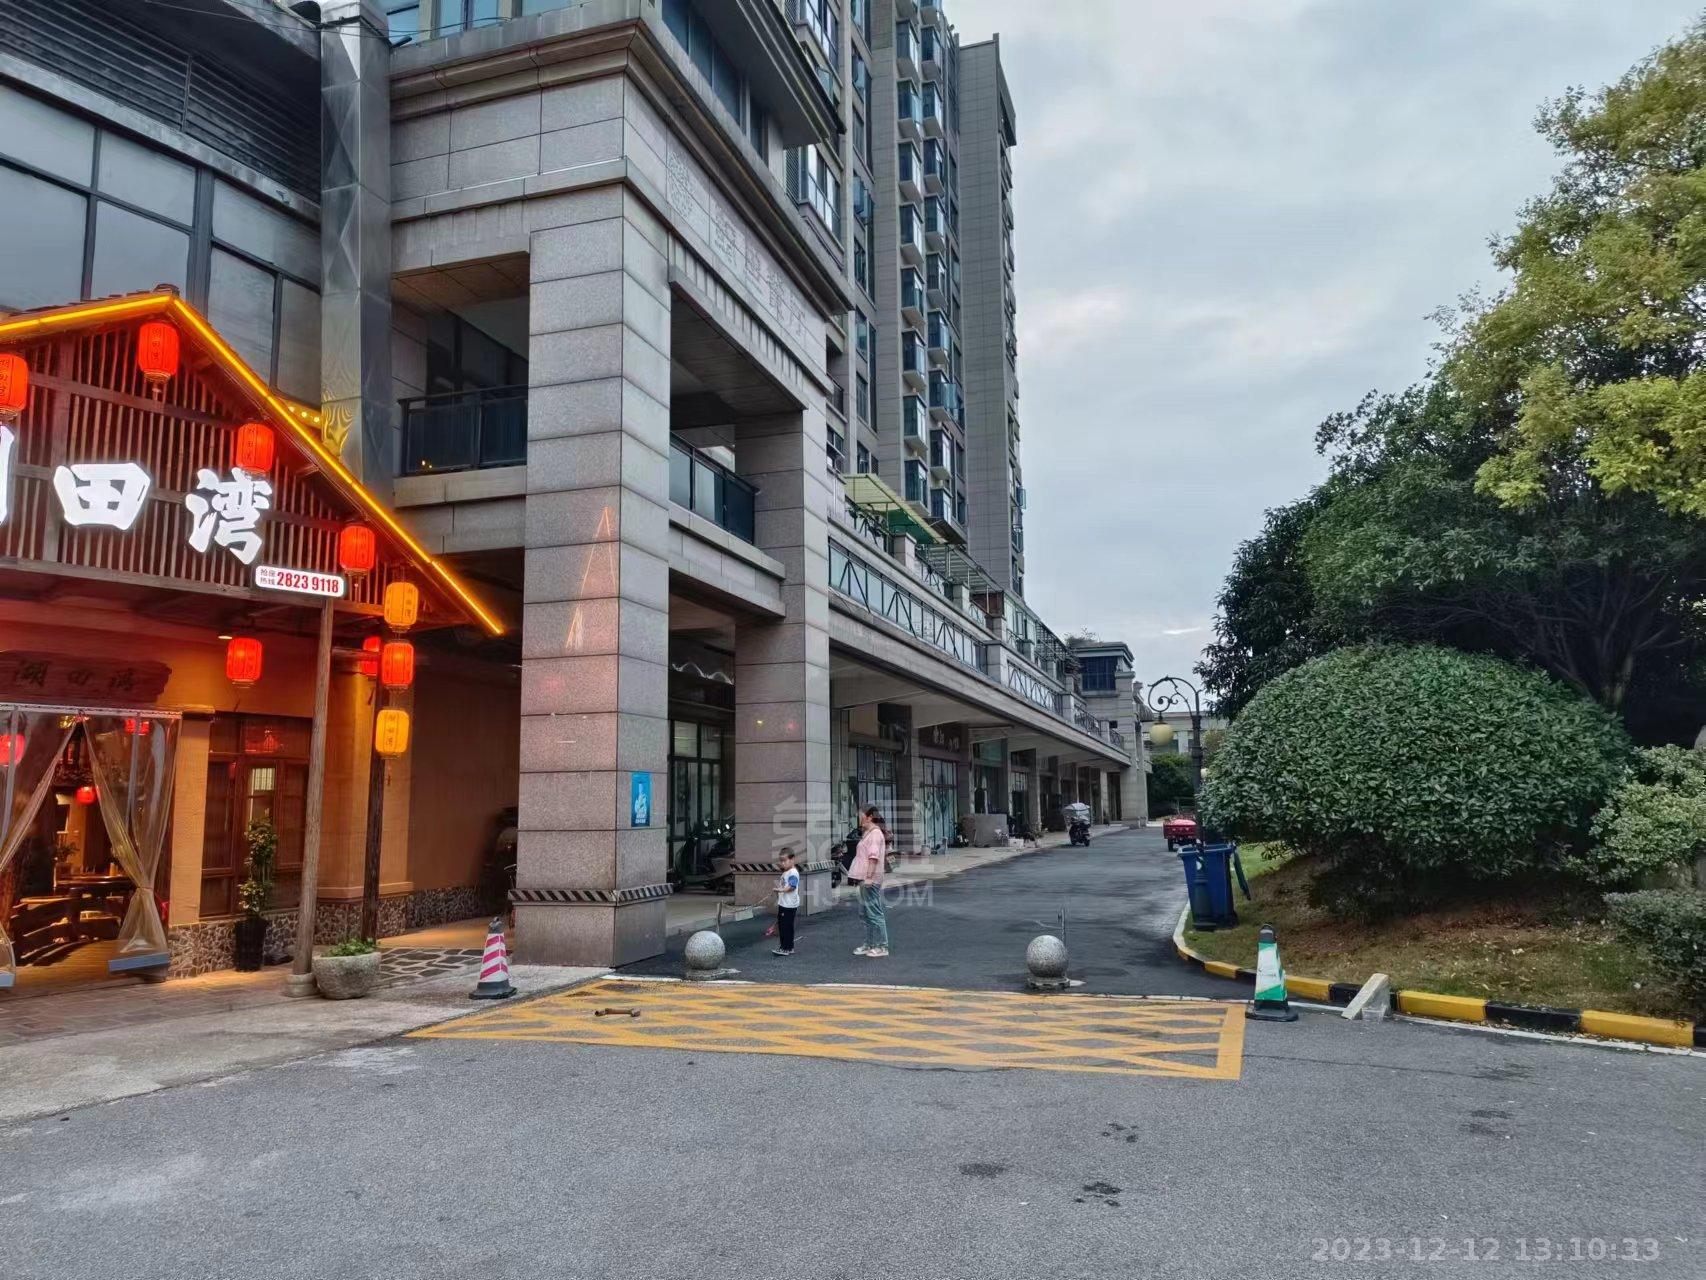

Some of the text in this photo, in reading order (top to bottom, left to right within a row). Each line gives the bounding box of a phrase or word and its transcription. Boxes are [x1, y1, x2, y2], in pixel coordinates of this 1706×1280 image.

[0, 425, 272, 565] 田湾
[277, 571, 339, 594] 2823 9118
